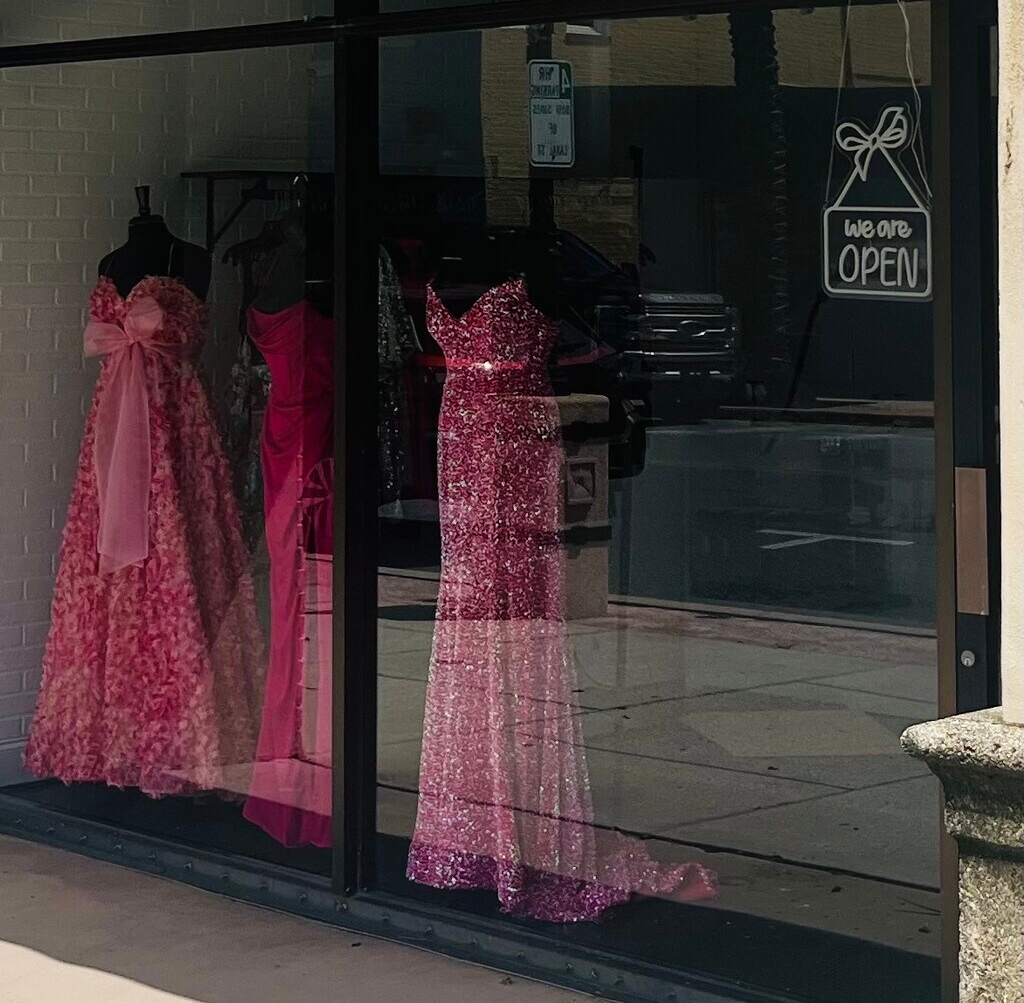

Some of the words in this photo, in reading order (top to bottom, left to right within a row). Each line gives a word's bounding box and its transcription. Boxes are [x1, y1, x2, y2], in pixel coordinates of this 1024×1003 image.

[844, 219, 875, 239] we
[876, 219, 913, 239] are
[838, 244, 918, 288] OPEN
